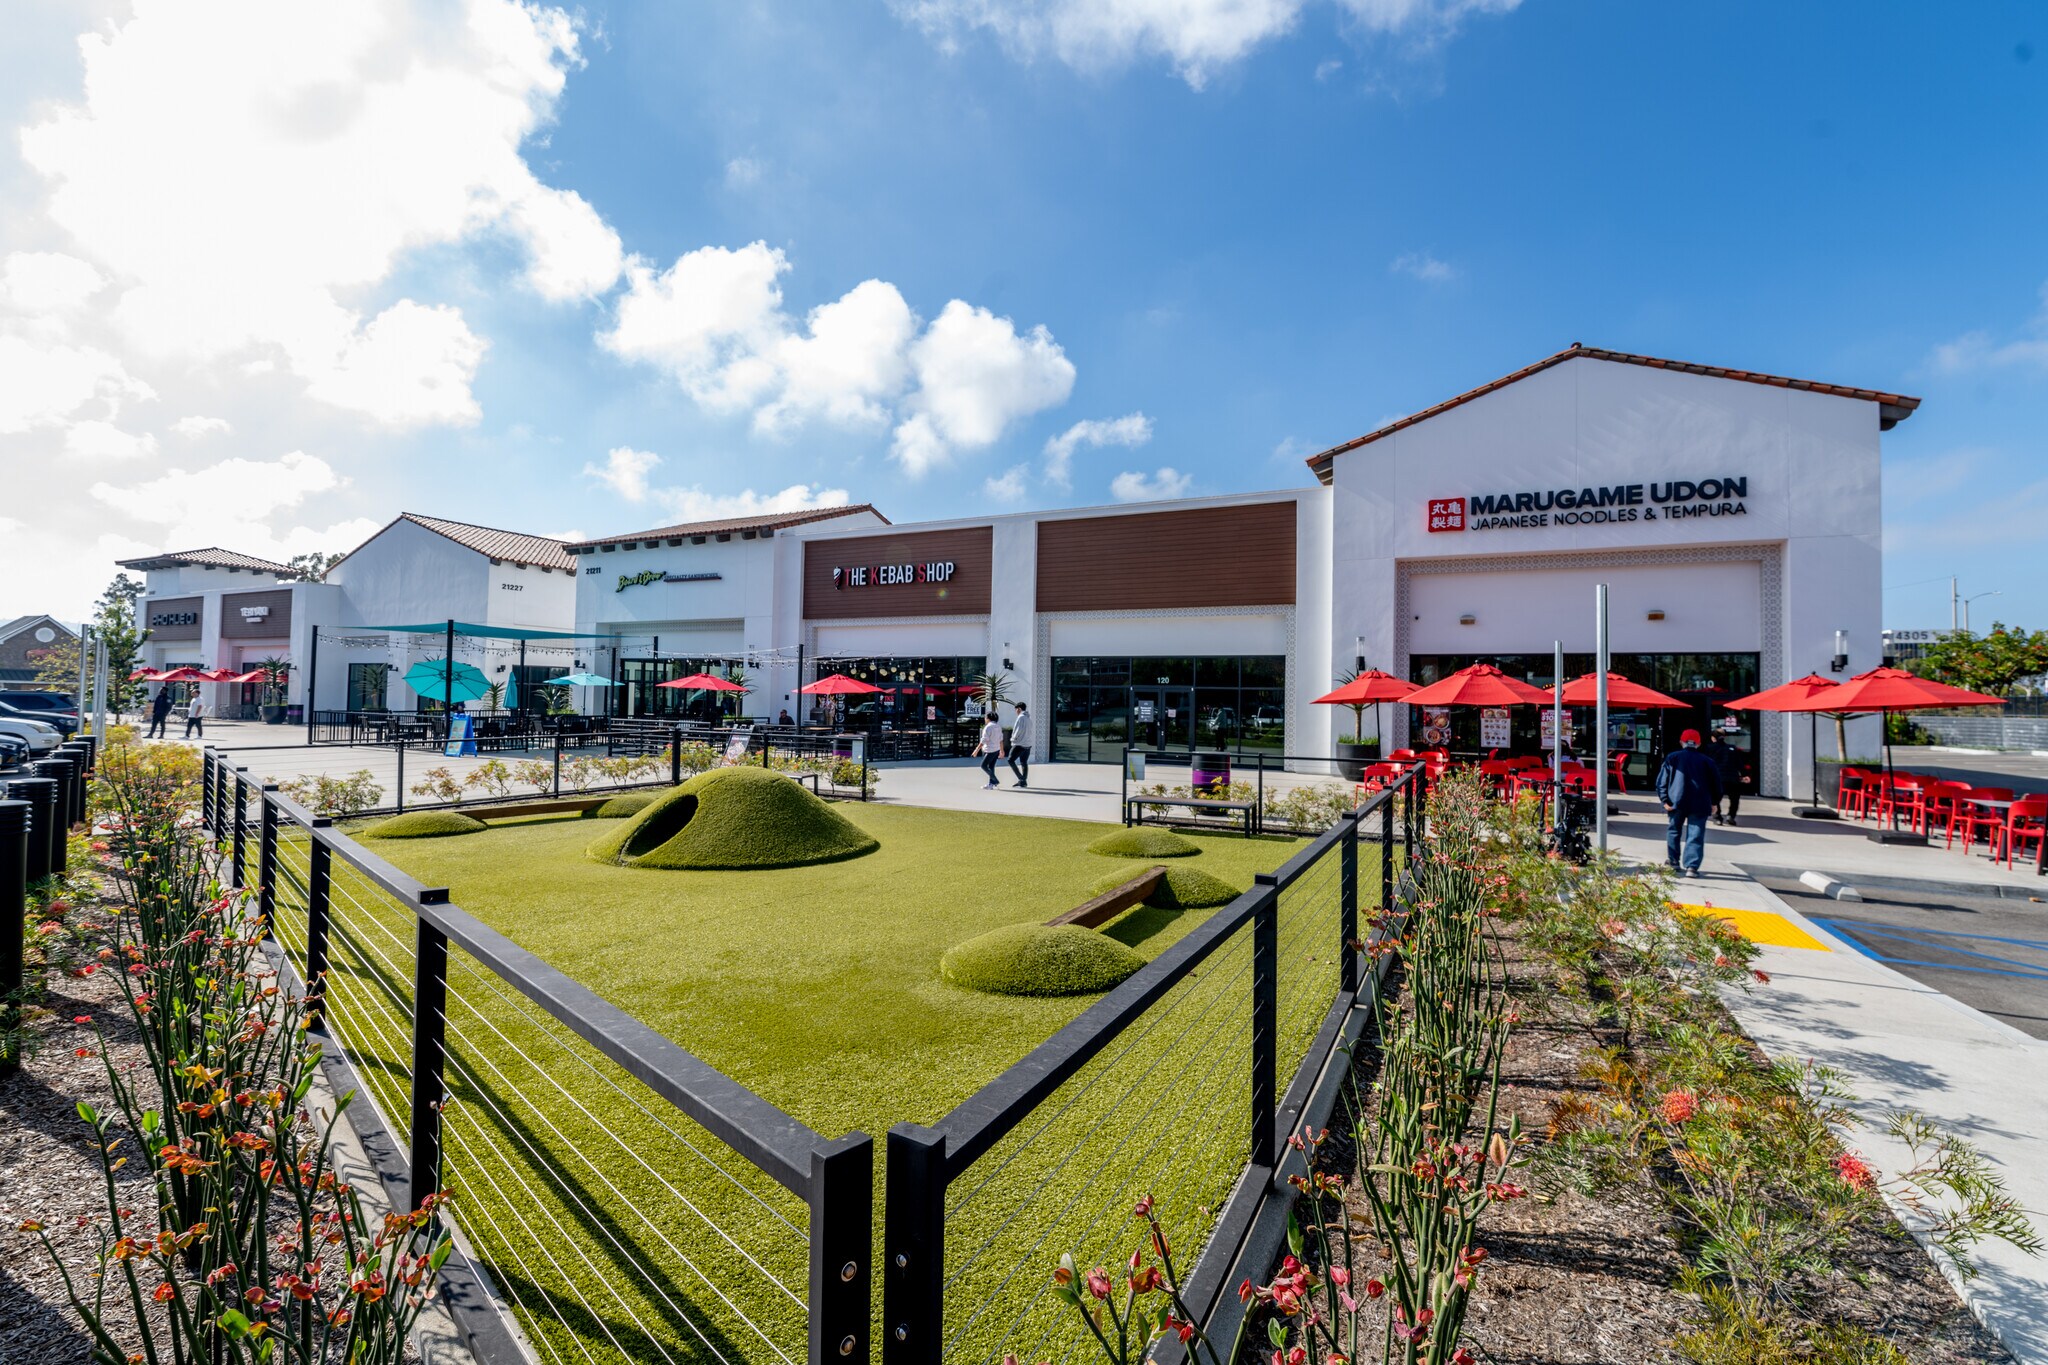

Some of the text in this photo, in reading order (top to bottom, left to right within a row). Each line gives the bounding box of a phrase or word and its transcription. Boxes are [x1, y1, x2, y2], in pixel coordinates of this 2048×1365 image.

[1470, 476, 1747, 516] MARUGAME UDON
[1431, 501, 1462, 515] 丸亀
[1471, 502, 1747, 531] JAPANESE NOODLES & TEMPURA
[585, 567, 601, 575] 21211
[844, 562, 955, 586] THE KEBAB SHOP
[501, 583, 524, 591] 21227
[1895, 631, 1929, 640] 4305
[1157, 676, 1170, 684] 120
[1694, 680, 1715, 689] 110
